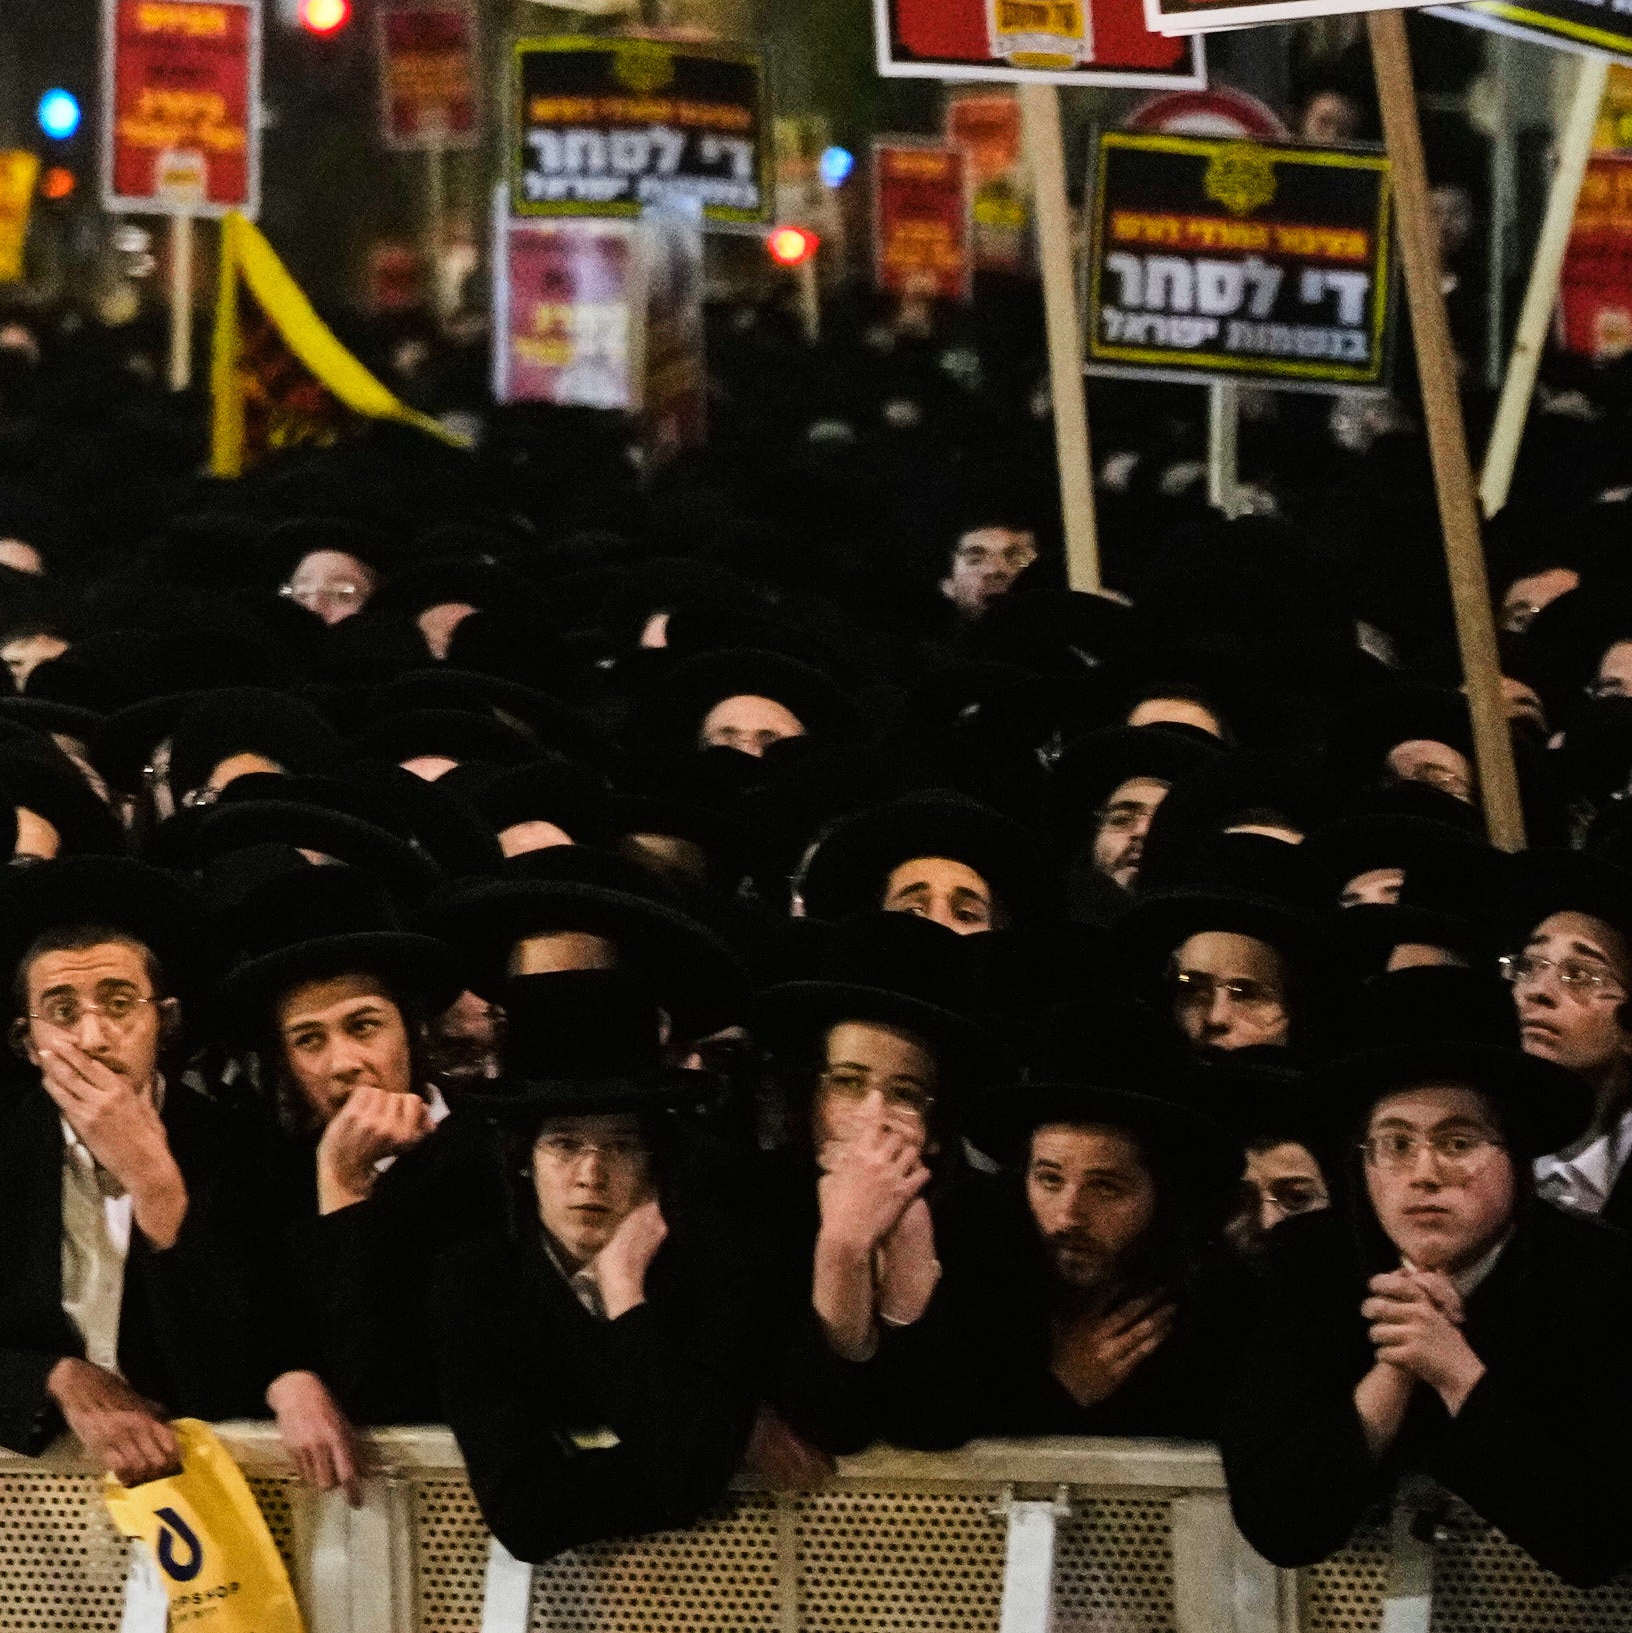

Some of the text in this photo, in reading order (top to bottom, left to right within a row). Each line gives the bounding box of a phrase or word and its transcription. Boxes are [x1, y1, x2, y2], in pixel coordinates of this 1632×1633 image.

[529, 123, 685, 174] לסחר
[1106, 252, 1370, 327] די לסחר
[1101, 304, 1220, 348] ישראל
